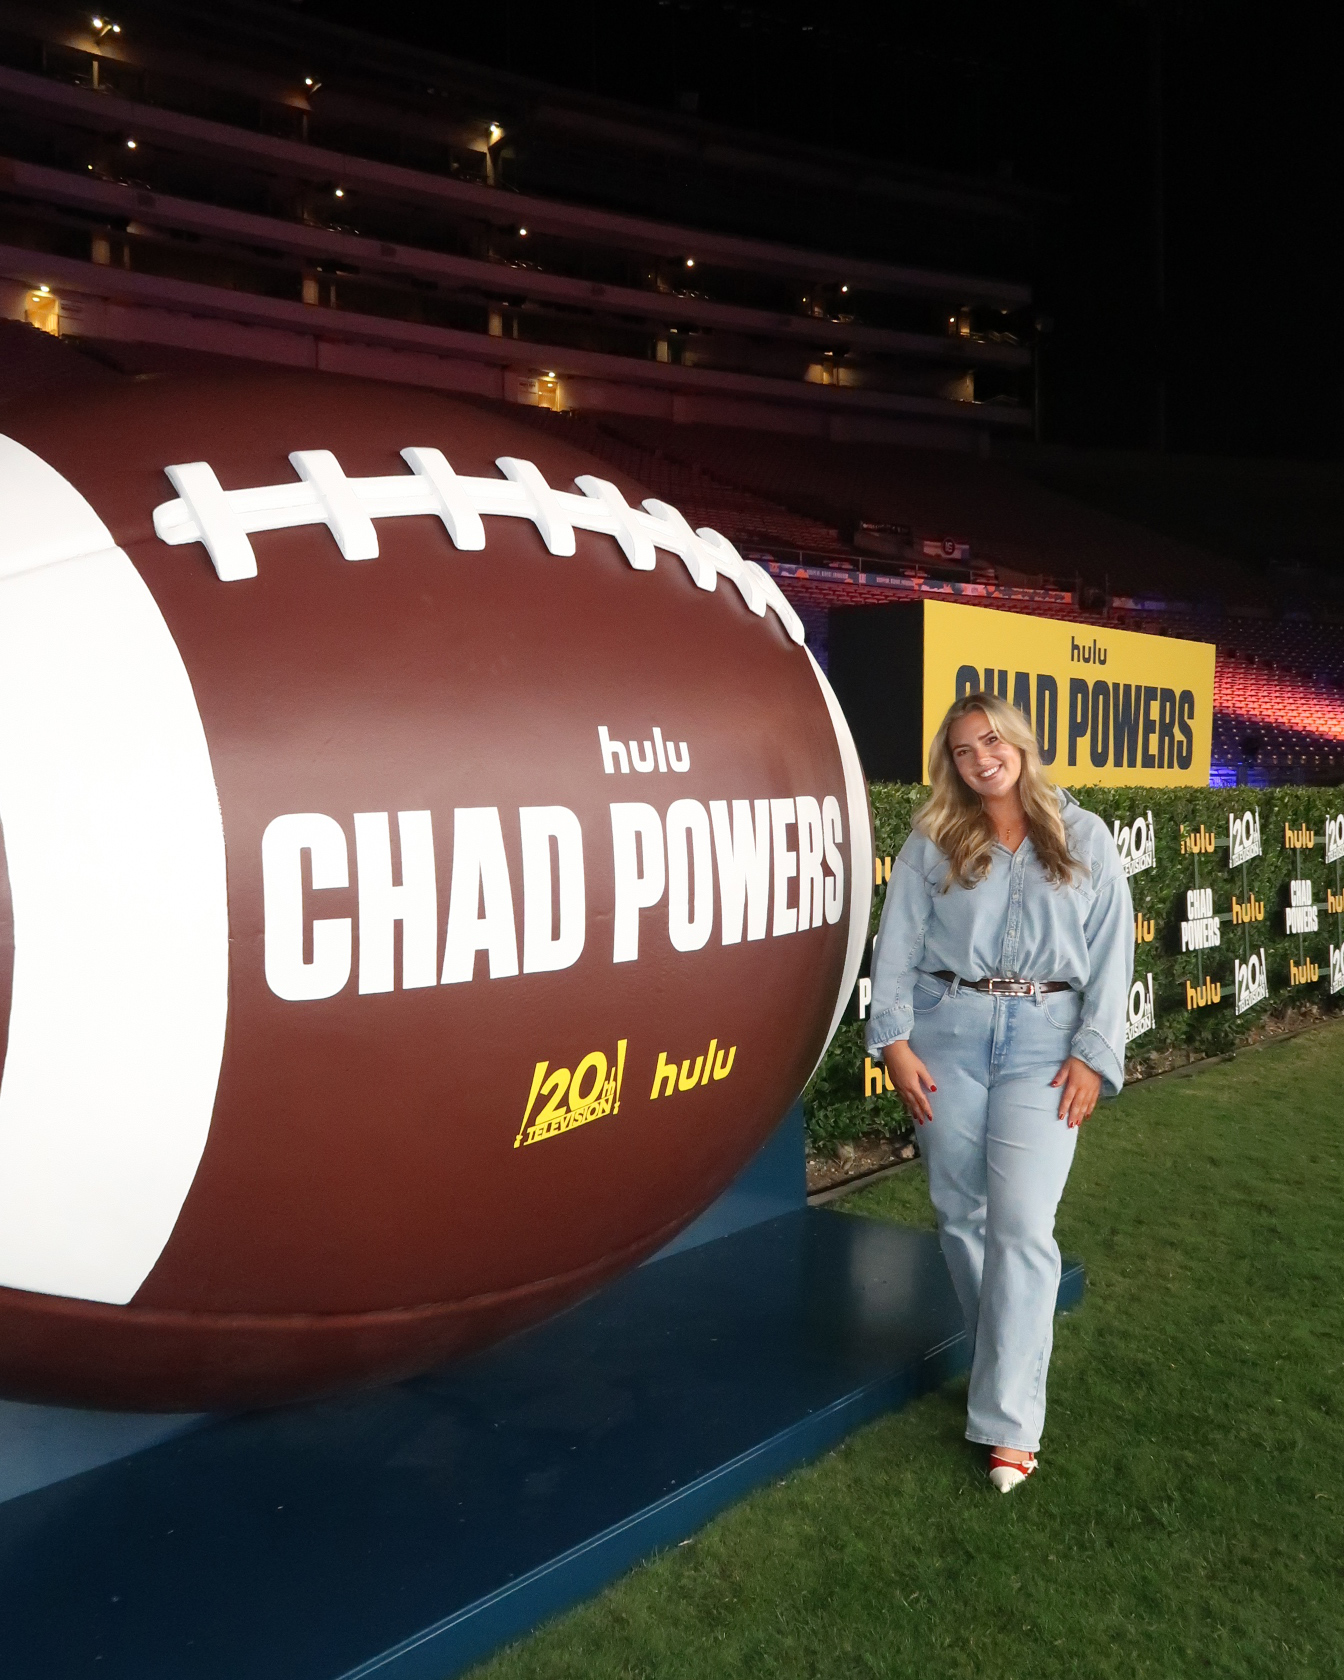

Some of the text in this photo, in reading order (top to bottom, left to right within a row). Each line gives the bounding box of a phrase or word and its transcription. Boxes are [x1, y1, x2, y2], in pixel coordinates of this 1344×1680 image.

[1071, 636, 1107, 665] hulu
[1068, 677, 1195, 770] POWERS
[598, 726, 691, 774] hulu
[1285, 822, 1314, 849] hulu
[261, 796, 843, 1001] CHAD POWERS
[1187, 888, 1213, 920] CHAD
[1232, 892, 1264, 924] hulu
[1290, 879, 1312, 907] CHAD
[1134, 912, 1155, 944] lu
[1181, 916, 1220, 952] POWERS
[1285, 905, 1319, 935] POWERS
[1290, 957, 1319, 985] hulu
[1186, 976, 1221, 1010] hulu
[650, 1038, 737, 1100] hulu
[524, 1095, 614, 1145] TELEVISION
